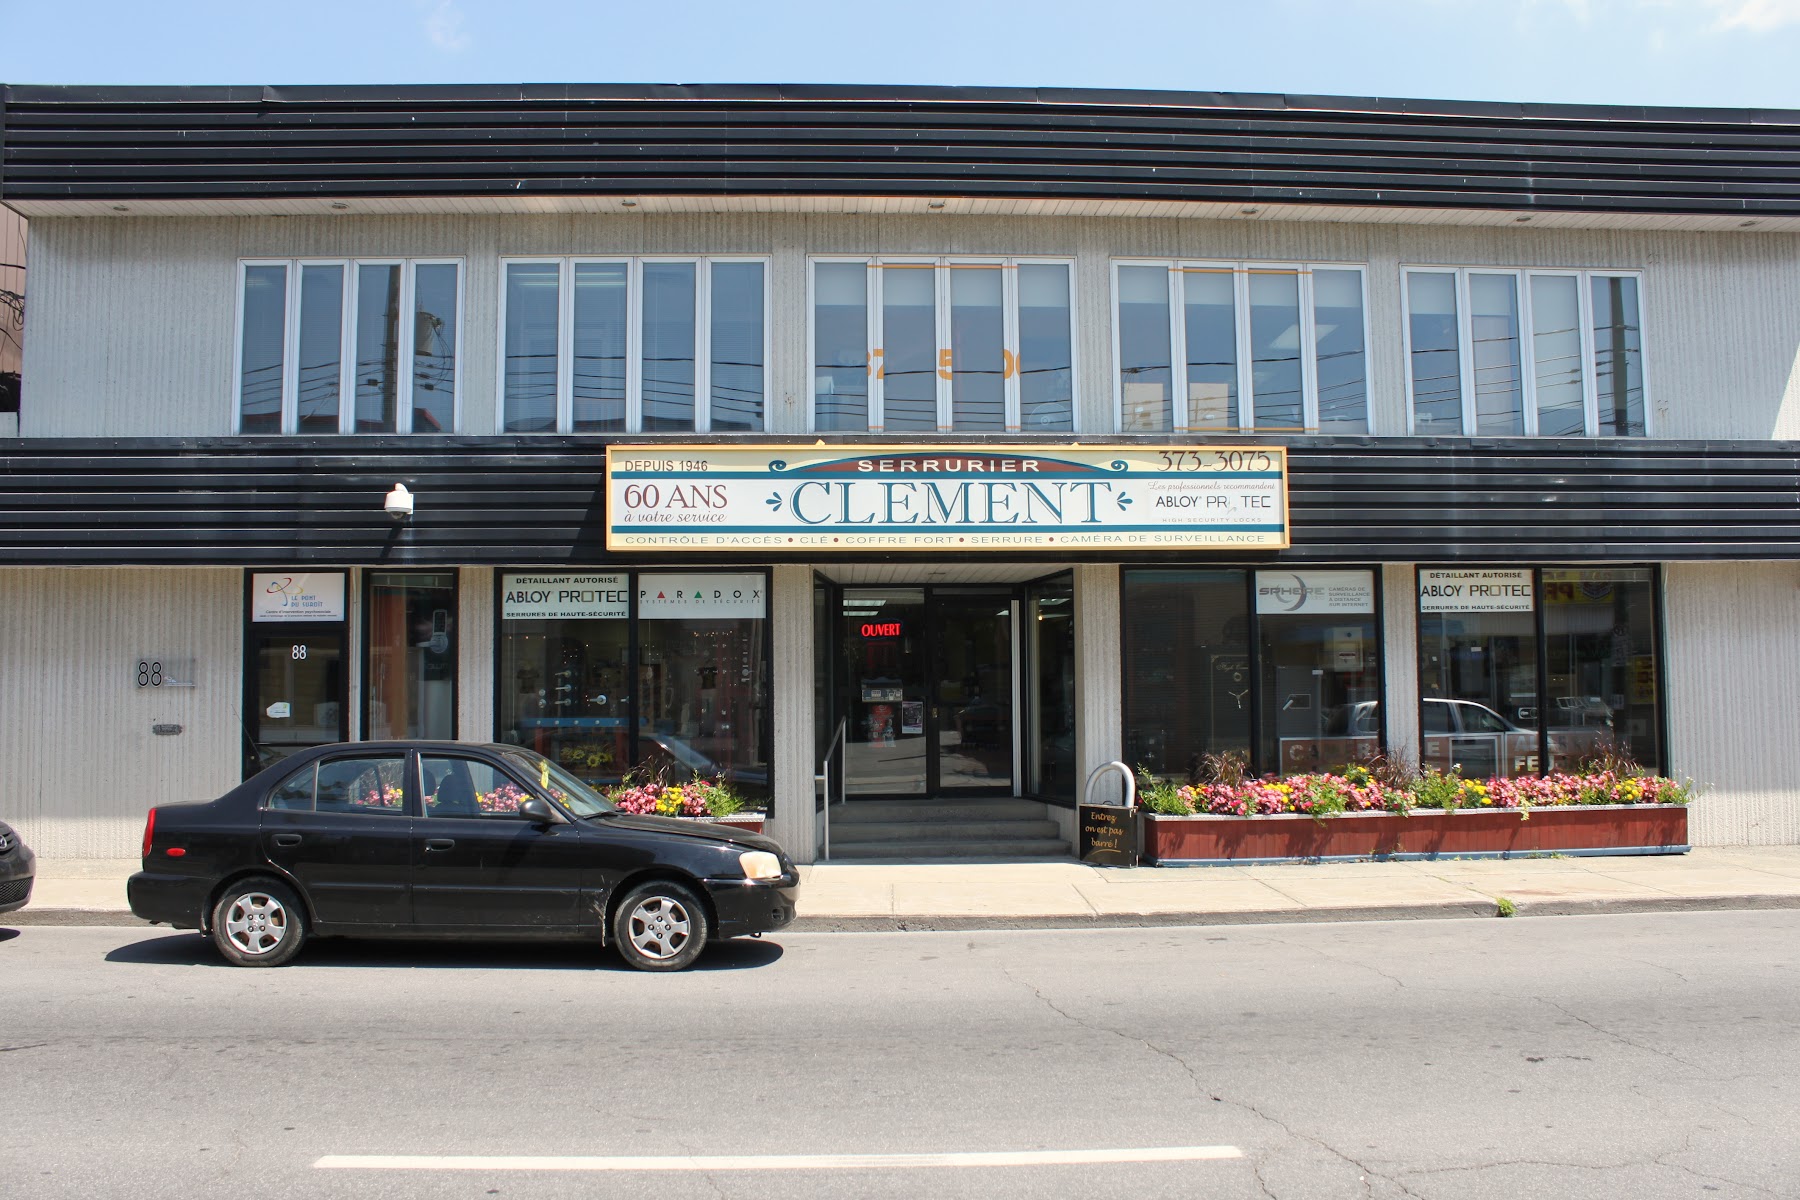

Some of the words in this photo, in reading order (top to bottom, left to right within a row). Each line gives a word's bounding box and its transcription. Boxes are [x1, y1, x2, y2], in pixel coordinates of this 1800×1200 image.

[625, 460, 674, 472] DEPUIS
[679, 460, 708, 472] 1946
[857, 459, 1040, 472] SERRURIER
[1157, 451, 1271, 471] 373-3075
[1148, 481, 1166, 490] Les
[1168, 481, 1221, 492] professionnels
[1223, 482, 1275, 490] recommandent
[624, 484, 660, 509] 60
[665, 484, 728, 509] ANS
[789, 481, 1112, 524] CLEMENT
[624, 510, 635, 523] à
[638, 511, 674, 523] votre
[676, 510, 727, 523] service
[625, 535, 709, 544] CONTRÔLE
[800, 535, 828, 544] CLÉ
[846, 536, 907, 544] COFFRE
[914, 536, 953, 544] FORT
[971, 536, 1043, 544] SERRURE
[1060, 534, 1122, 543] CAMÉRA
[1128, 535, 1147, 543] DE
[1154, 534, 1265, 542] SURVEILLANCE
[505, 591, 551, 603] ABLOY
[558, 590, 628, 603] PROTEC
[1469, 585, 1531, 597] PROTEC
[861, 623, 901, 637] OUVERT
[292, 644, 307, 660] 88
[138, 661, 162, 687] 88
